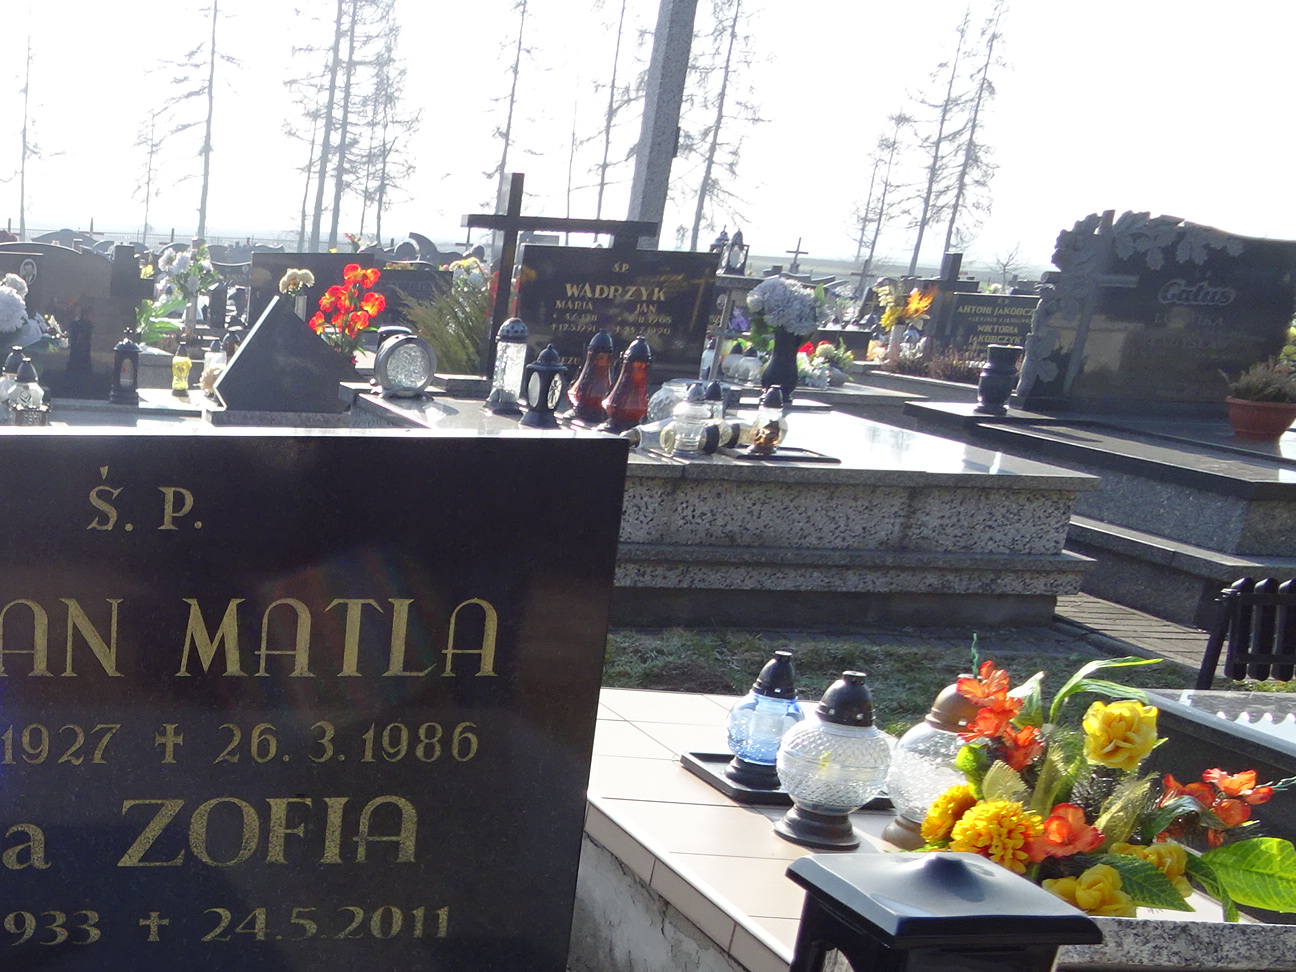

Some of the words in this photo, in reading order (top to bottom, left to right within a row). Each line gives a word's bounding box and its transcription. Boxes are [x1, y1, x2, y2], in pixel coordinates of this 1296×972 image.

[555, 300, 593, 310] MARIA
[174, 597, 500, 678] MATLA
[117, 795, 418, 868] ZOFIA
[200, 904, 451, 942] 24.5.2011
